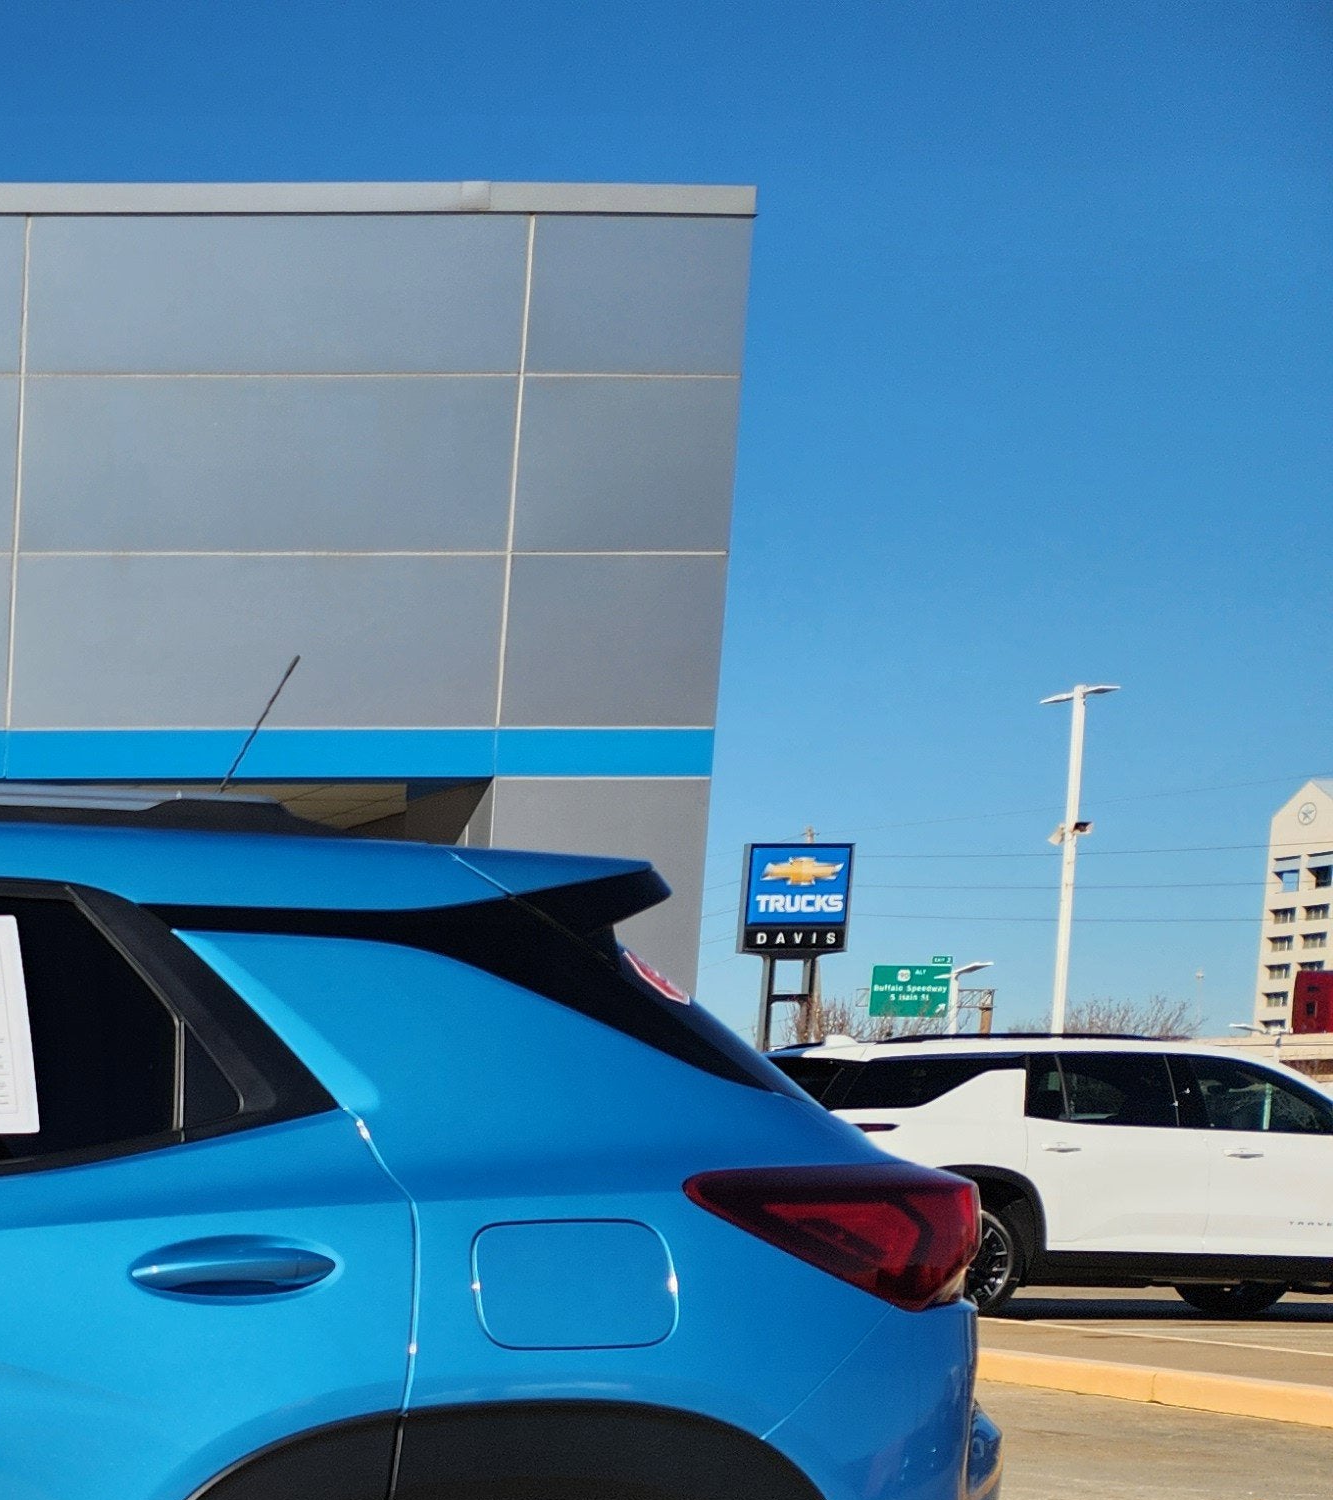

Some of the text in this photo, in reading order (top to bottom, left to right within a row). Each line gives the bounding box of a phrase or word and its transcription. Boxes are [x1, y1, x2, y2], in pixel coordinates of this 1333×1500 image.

[755, 894, 844, 913] TRUCKS
[756, 932, 836, 945] DAVIS
[873, 984, 948, 994] Buffalo Speedway
